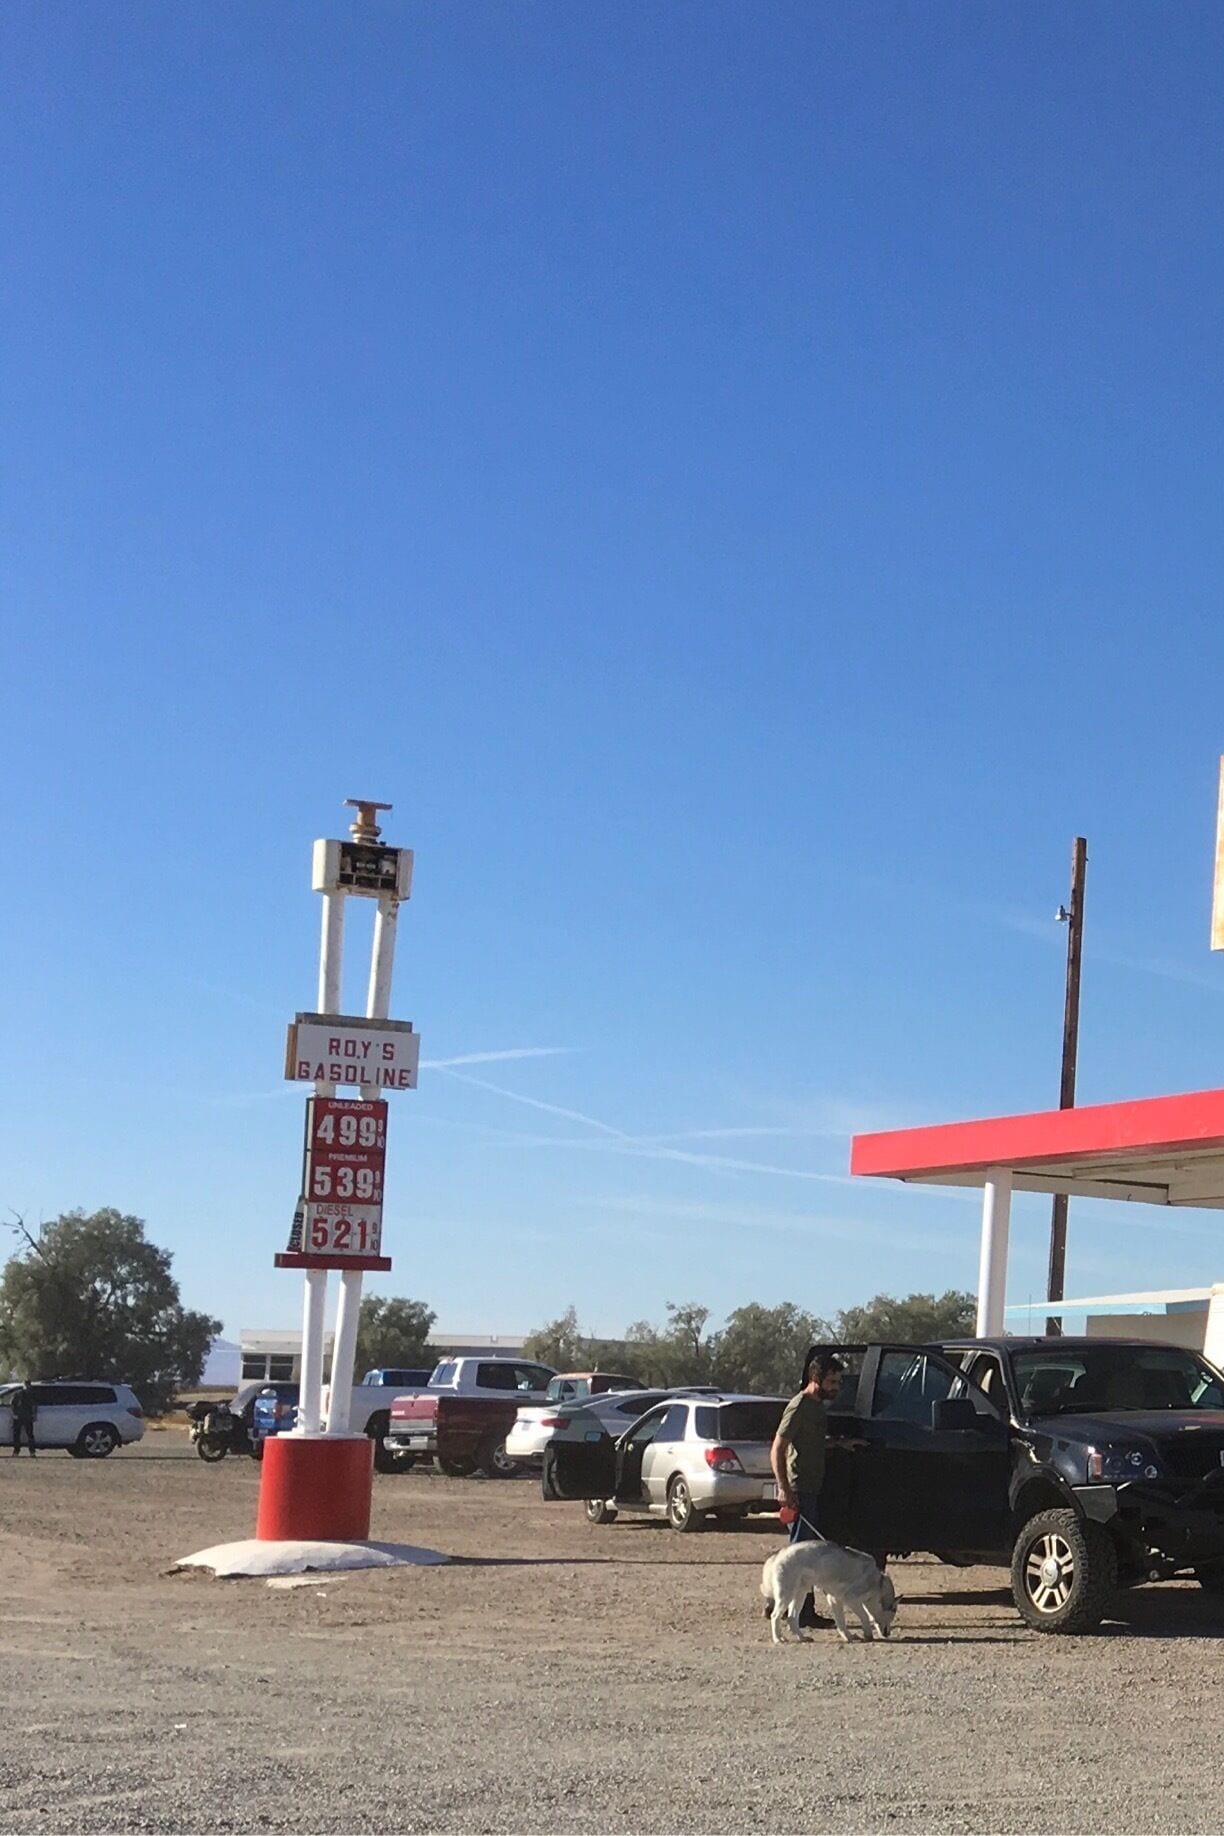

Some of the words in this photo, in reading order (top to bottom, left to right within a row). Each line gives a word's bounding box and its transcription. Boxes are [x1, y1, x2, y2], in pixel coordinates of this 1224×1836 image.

[328, 1038, 395, 1060] ROY'S
[298, 1060, 411, 1087] GASOLINE
[328, 1101, 373, 1111] UNLEADED
[328, 1153, 368, 1162] PREMIUM
[316, 1204, 354, 1217] DIESEL
[289, 1211, 304, 1248] CLOSED
